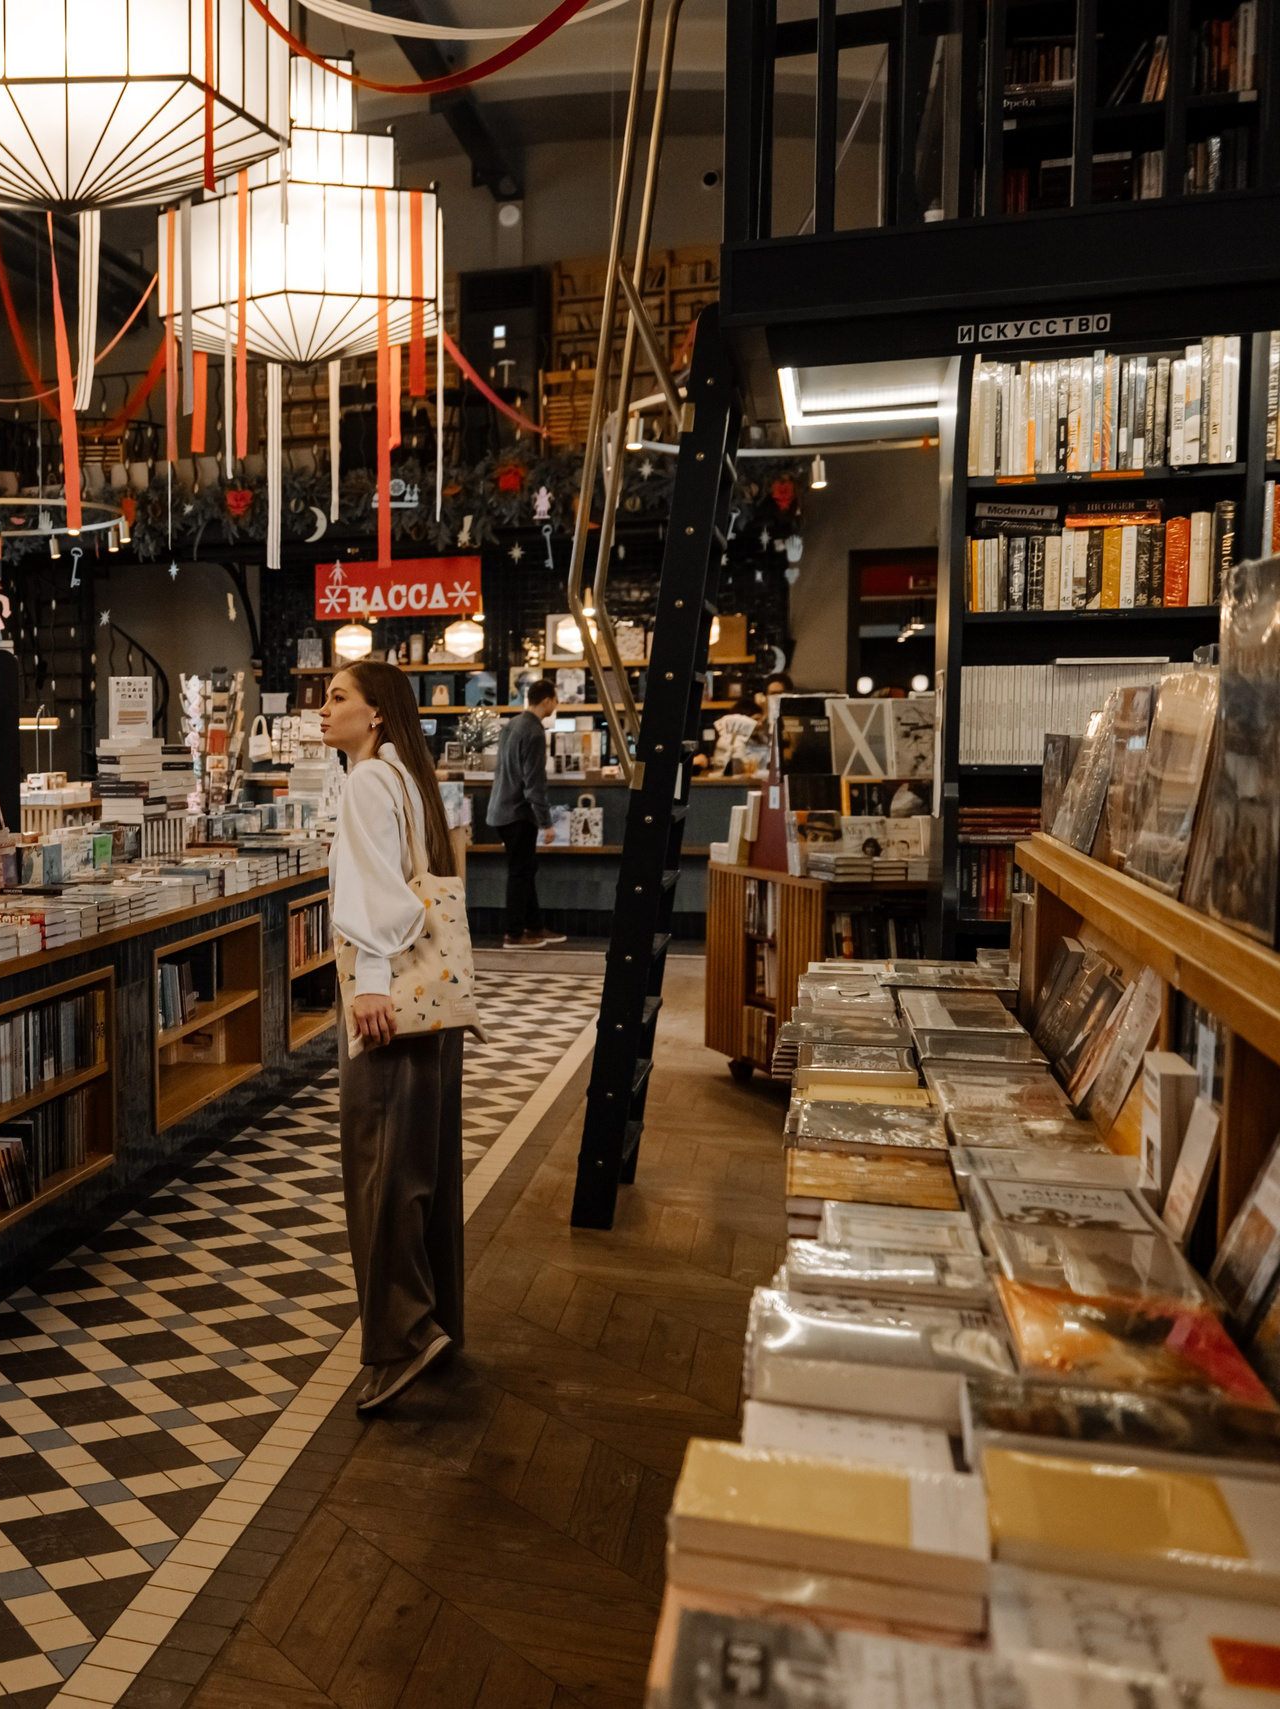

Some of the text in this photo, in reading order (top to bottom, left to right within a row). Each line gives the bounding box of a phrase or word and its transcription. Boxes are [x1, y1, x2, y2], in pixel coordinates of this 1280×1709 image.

[959, 315, 1109, 342] ИСКУССТВО
[1173, 393, 1184, 431] JOE ZUCKER
[987, 505, 1045, 516] Modern Art
[1221, 532, 1235, 555] Van
[1009, 552, 1024, 602] Van Gogh
[347, 583, 449, 613] КАССА
